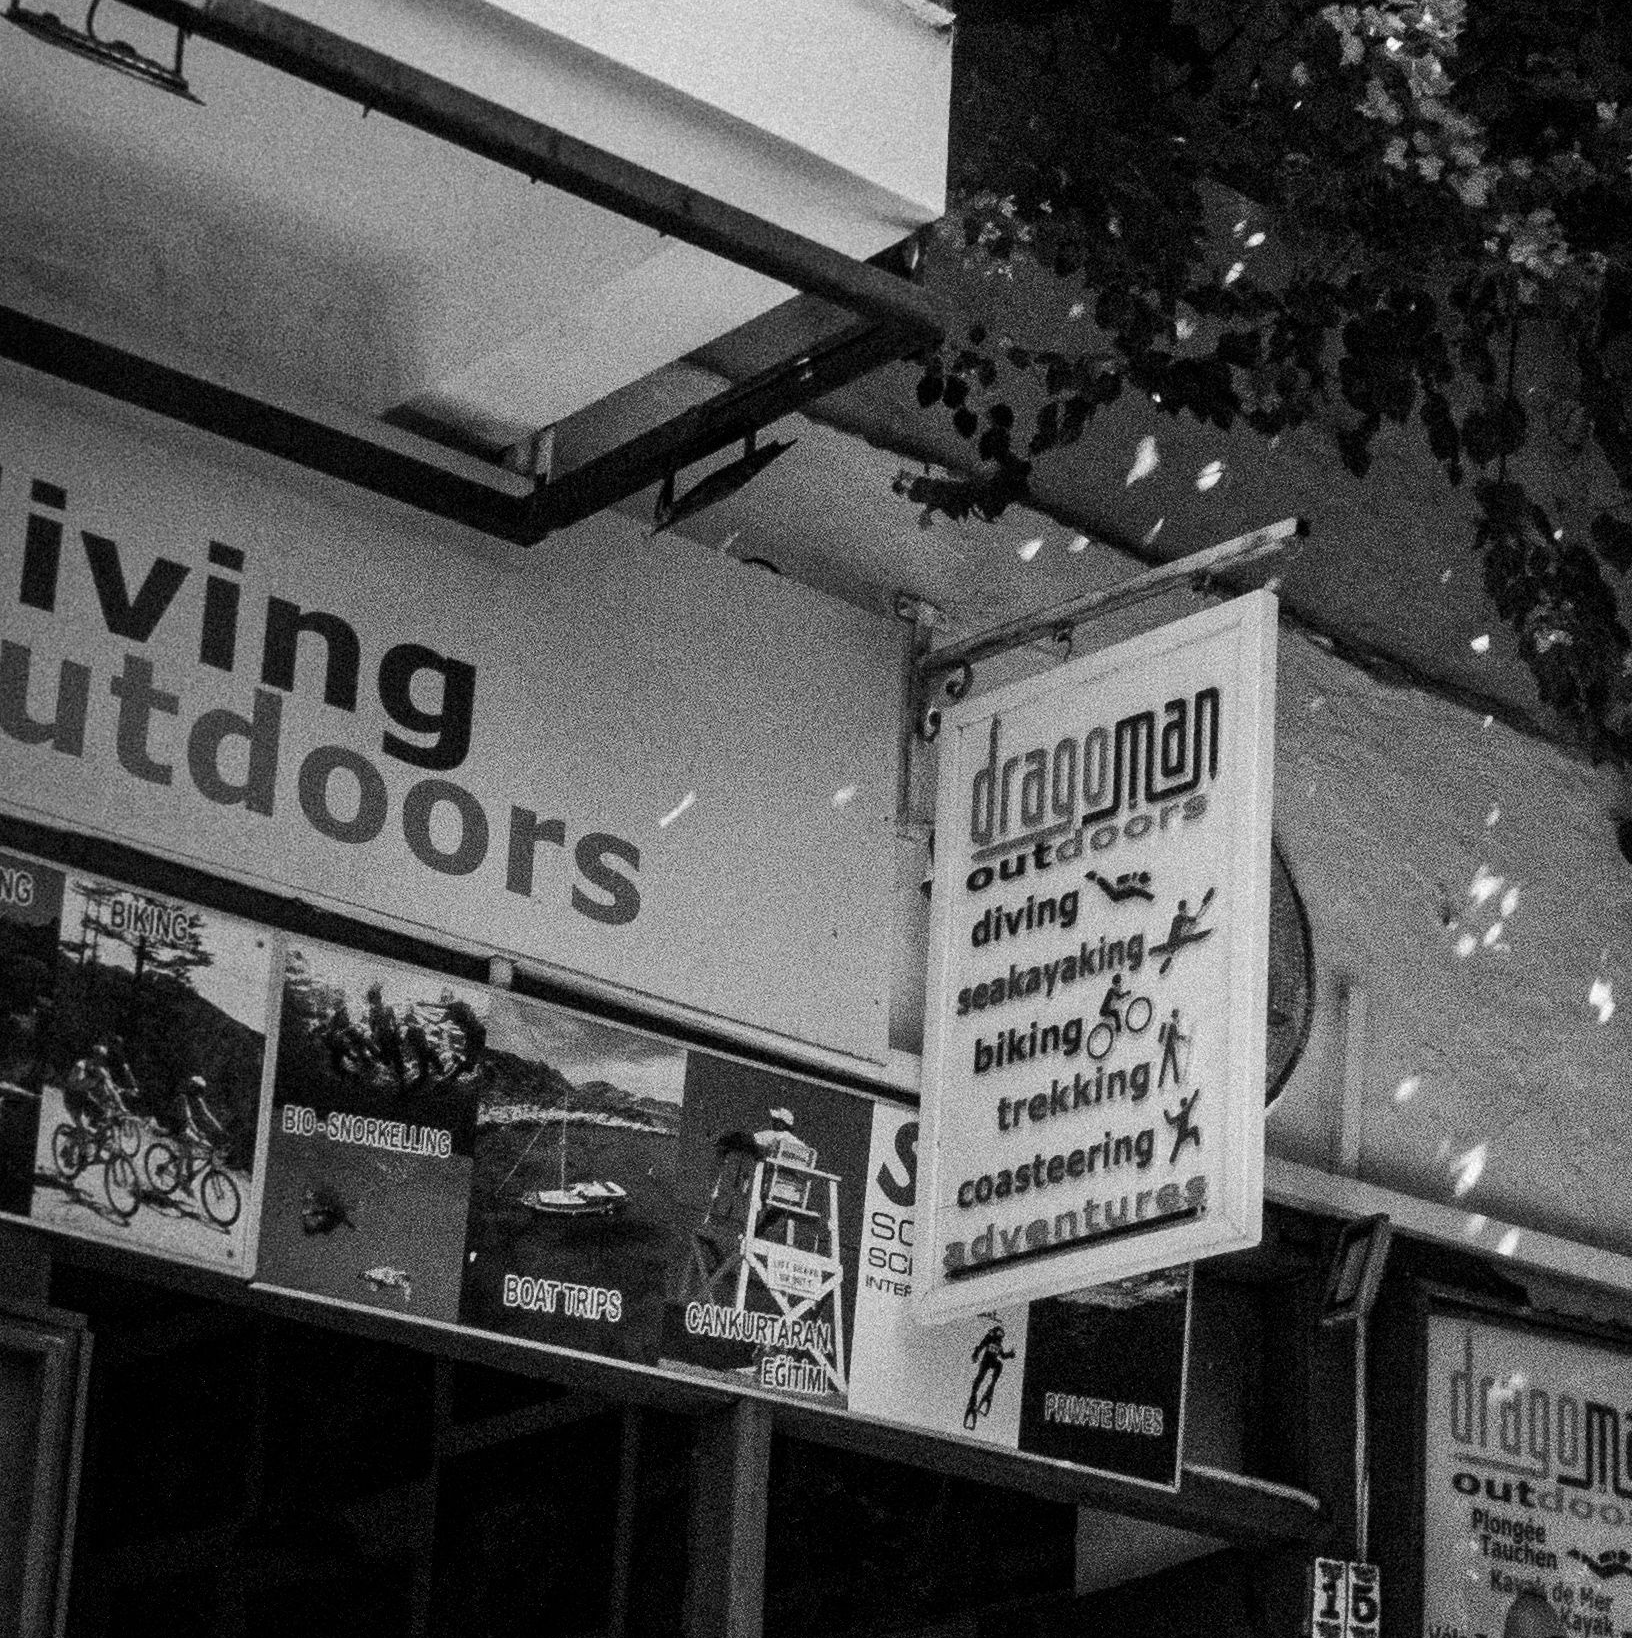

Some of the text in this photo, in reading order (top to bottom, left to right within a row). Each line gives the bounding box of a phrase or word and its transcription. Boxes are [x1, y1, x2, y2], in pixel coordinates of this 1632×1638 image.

[0, 469, 476, 772] iving
[969, 685, 1220, 846] dragoman
[965, 792, 1211, 893] outdoors
[108, 881, 191, 941] BIKING
[971, 885, 1081, 949] diving
[956, 925, 1145, 1018] seakayaking
[972, 1011, 1086, 1076] biking
[996, 1057, 1153, 1132] trekking
[956, 1121, 1157, 1210] coasteering
[942, 1174, 1209, 1271] adventures
[503, 1274, 623, 1323] BOAT TRIPS
[685, 1301, 833, 1355] CANKURTARAN
[1043, 1391, 1164, 1437] PRIVATE DIVES
[1480, 1534, 1558, 1571] Tauchen
[1319, 1582, 1379, 1625] 15
